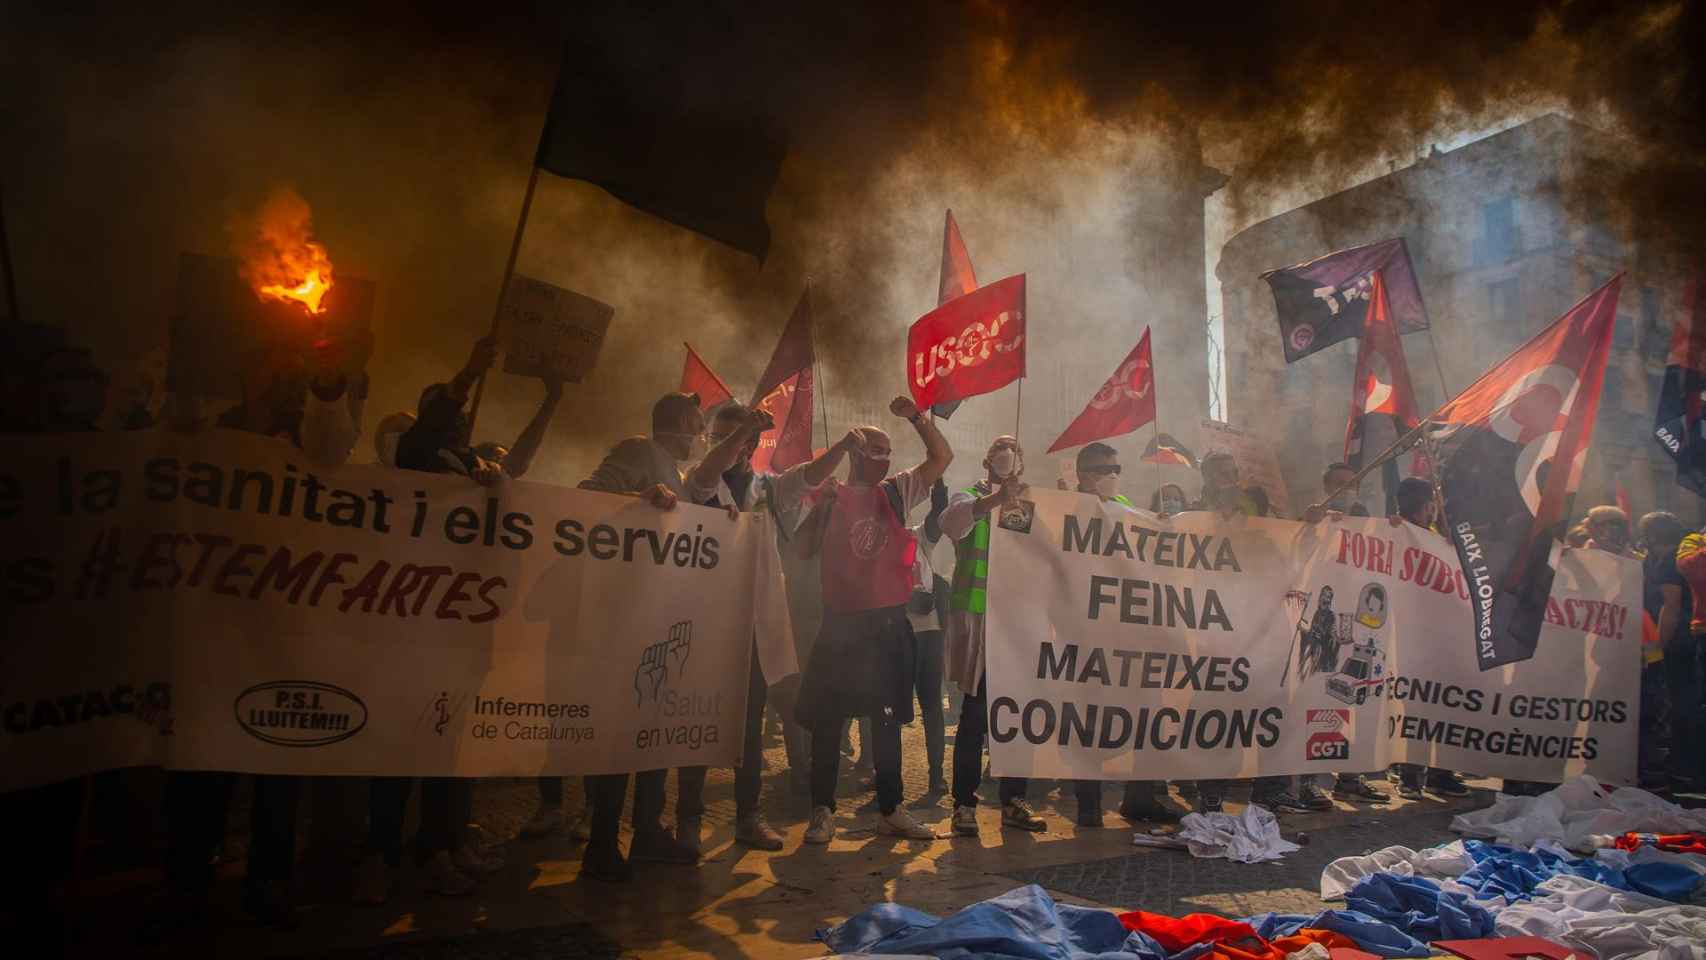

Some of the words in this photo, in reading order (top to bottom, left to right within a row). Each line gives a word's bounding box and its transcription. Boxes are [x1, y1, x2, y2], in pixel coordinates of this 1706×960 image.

[1656, 427, 1681, 453] BAIX
[56, 457, 120, 515] la
[145, 457, 394, 533] sanitat
[412, 491, 427, 537] i
[444, 498, 534, 550] els
[554, 519, 719, 569] serveis
[1062, 514, 1242, 573] MATEIXA
[1336, 527, 1393, 577] FORA
[1088, 575, 1234, 632] FEINA
[1455, 521, 1482, 562] BAIX
[1472, 566, 1497, 660] LLOBREGAT
[1037, 641, 1250, 693] MATEIXES
[275, 690, 324, 709] P.S.I.
[474, 695, 590, 719] Infermeres
[664, 690, 721, 717] Salut
[1491, 693, 1500, 715] I
[1510, 695, 1627, 723] GESTORS
[250, 711, 349, 731] LLUITEM!!!
[472, 722, 498, 740] de
[504, 722, 595, 743] Catalunya
[990, 696, 1282, 750] CONDICIONS
[636, 728, 660, 749] en
[665, 723, 719, 750] vaga
[1311, 741, 1345, 757] CGT
